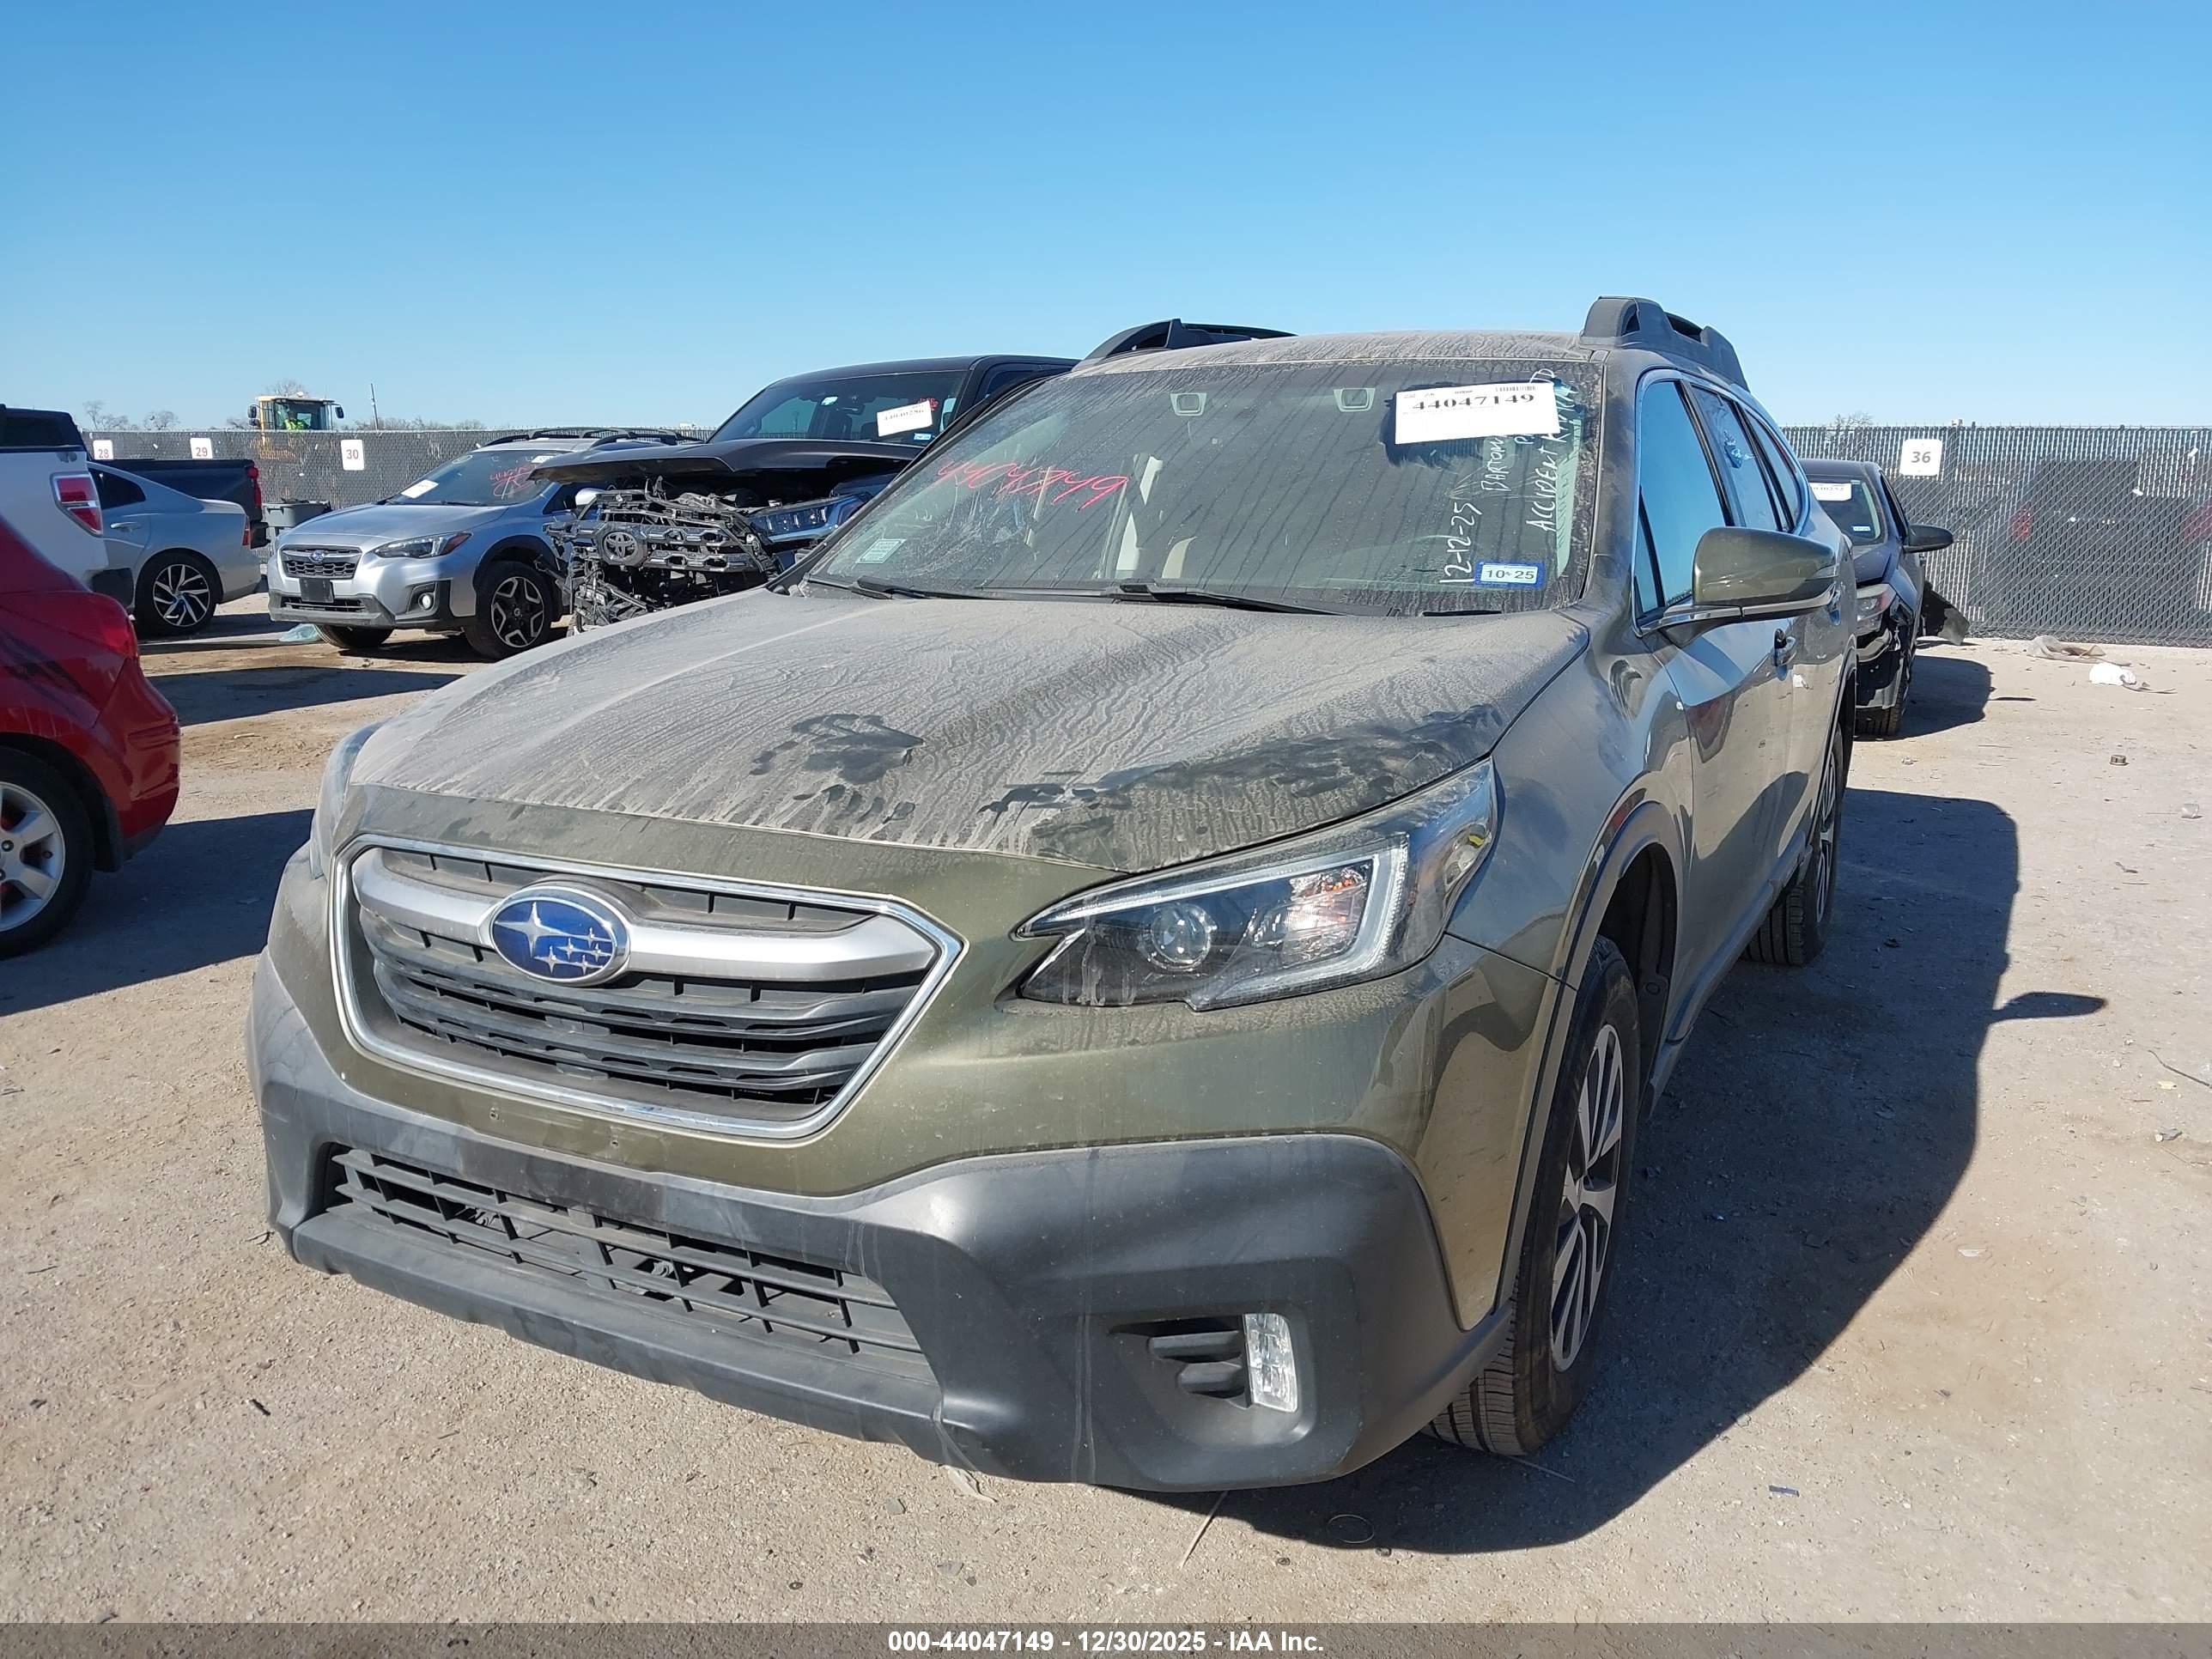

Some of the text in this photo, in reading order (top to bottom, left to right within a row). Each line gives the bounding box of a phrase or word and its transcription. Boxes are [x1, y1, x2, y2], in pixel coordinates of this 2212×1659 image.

[1412, 393, 1534, 410] 44047149
[98, 448, 109, 459] 28
[196, 447, 208, 457] 29
[345, 448, 359, 459] 30
[1911, 451, 1931, 464] 36
[1439, 501, 1483, 584] 12-12-25
